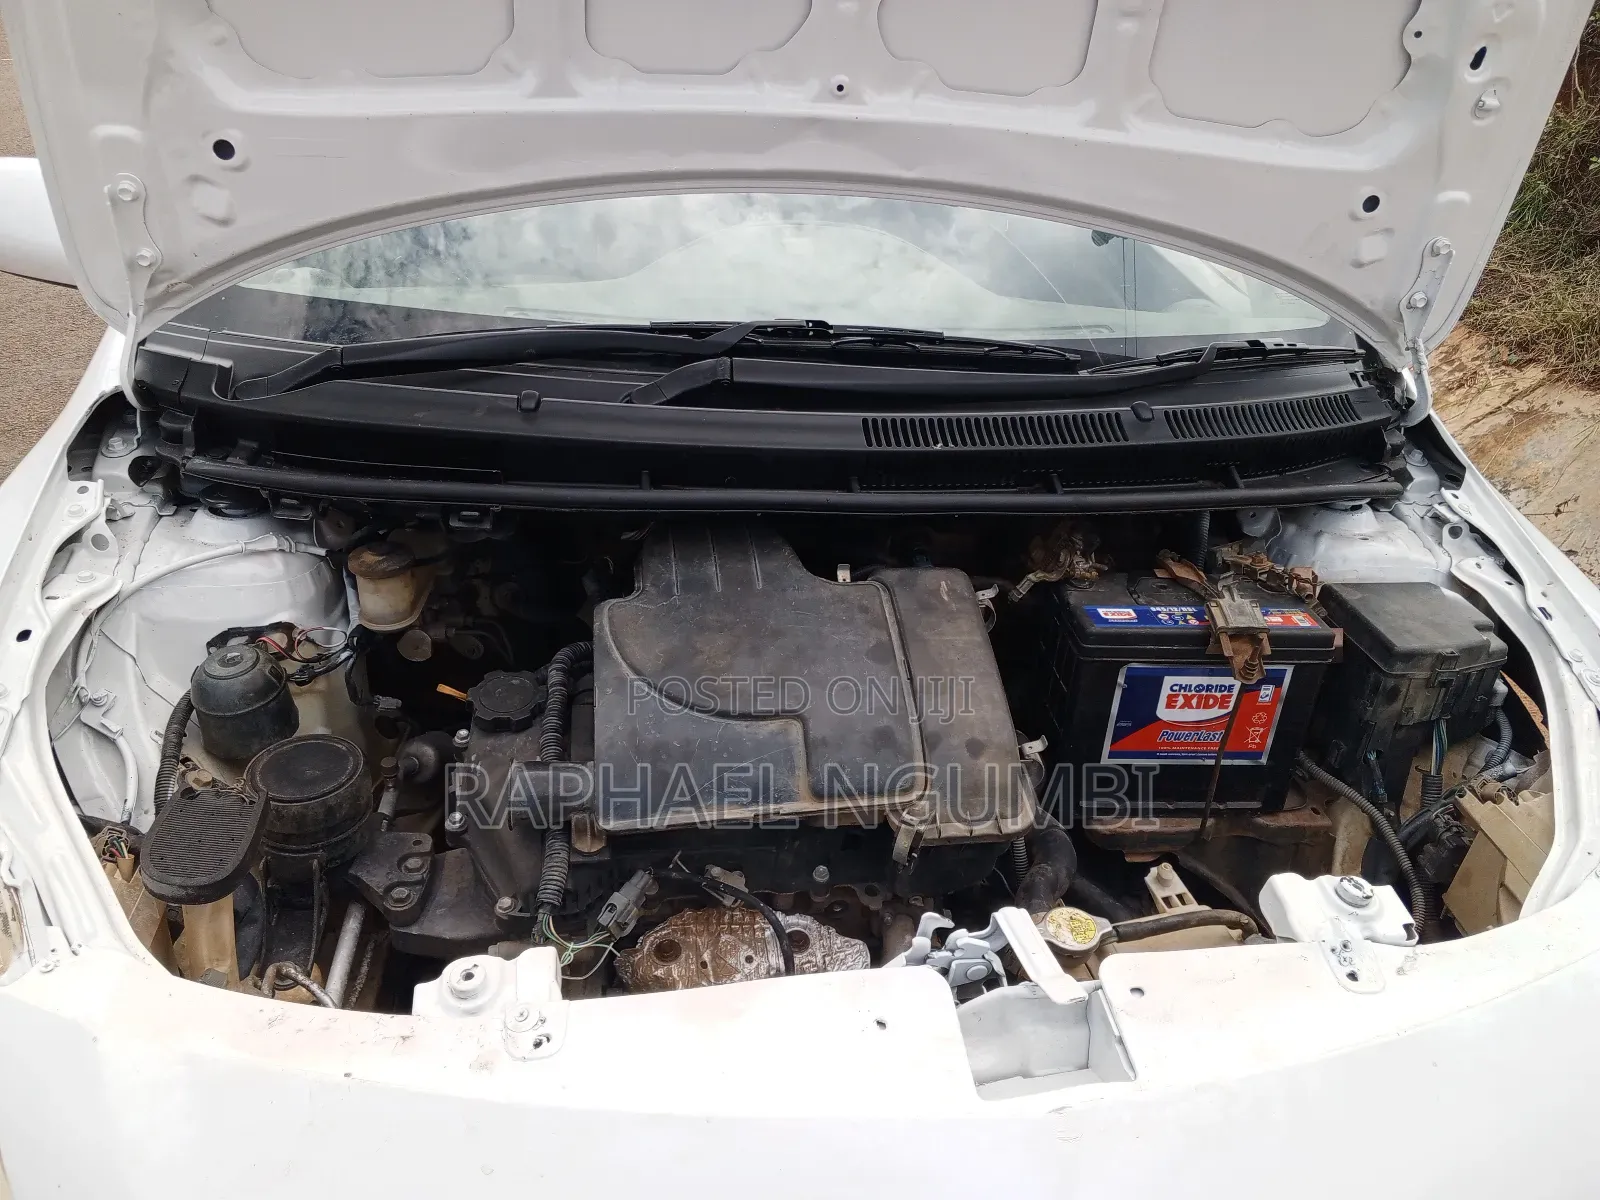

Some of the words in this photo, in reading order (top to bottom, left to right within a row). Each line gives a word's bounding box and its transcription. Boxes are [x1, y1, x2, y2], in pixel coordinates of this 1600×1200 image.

[1169, 683, 1236, 694] CHLORIDE
[1165, 693, 1234, 710] EXIDE
[1157, 729, 1225, 743] PowerLast
